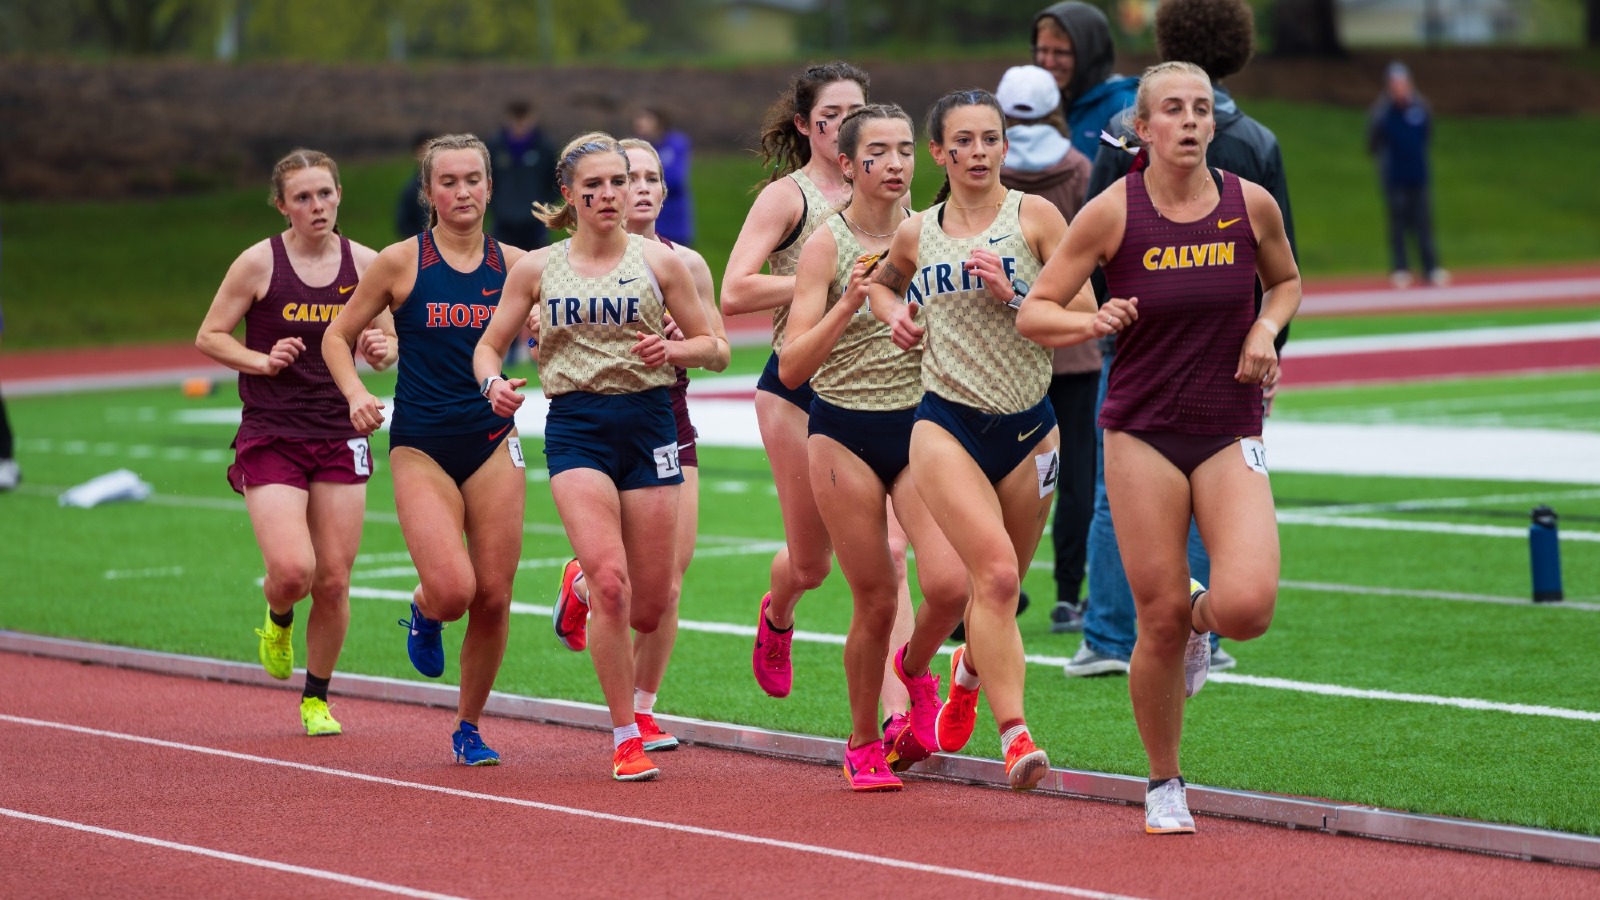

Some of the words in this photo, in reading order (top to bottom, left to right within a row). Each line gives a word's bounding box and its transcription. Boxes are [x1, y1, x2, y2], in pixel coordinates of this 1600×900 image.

[815, 120, 827, 135] T
[948, 149, 958, 164] T
[862, 159, 874, 174] T
[582, 194, 594, 208] T
[1143, 242, 1235, 270] CALVIN
[282, 302, 347, 322] CALVI
[546, 295, 641, 328] TRINE
[1043, 451, 1059, 487] 4
